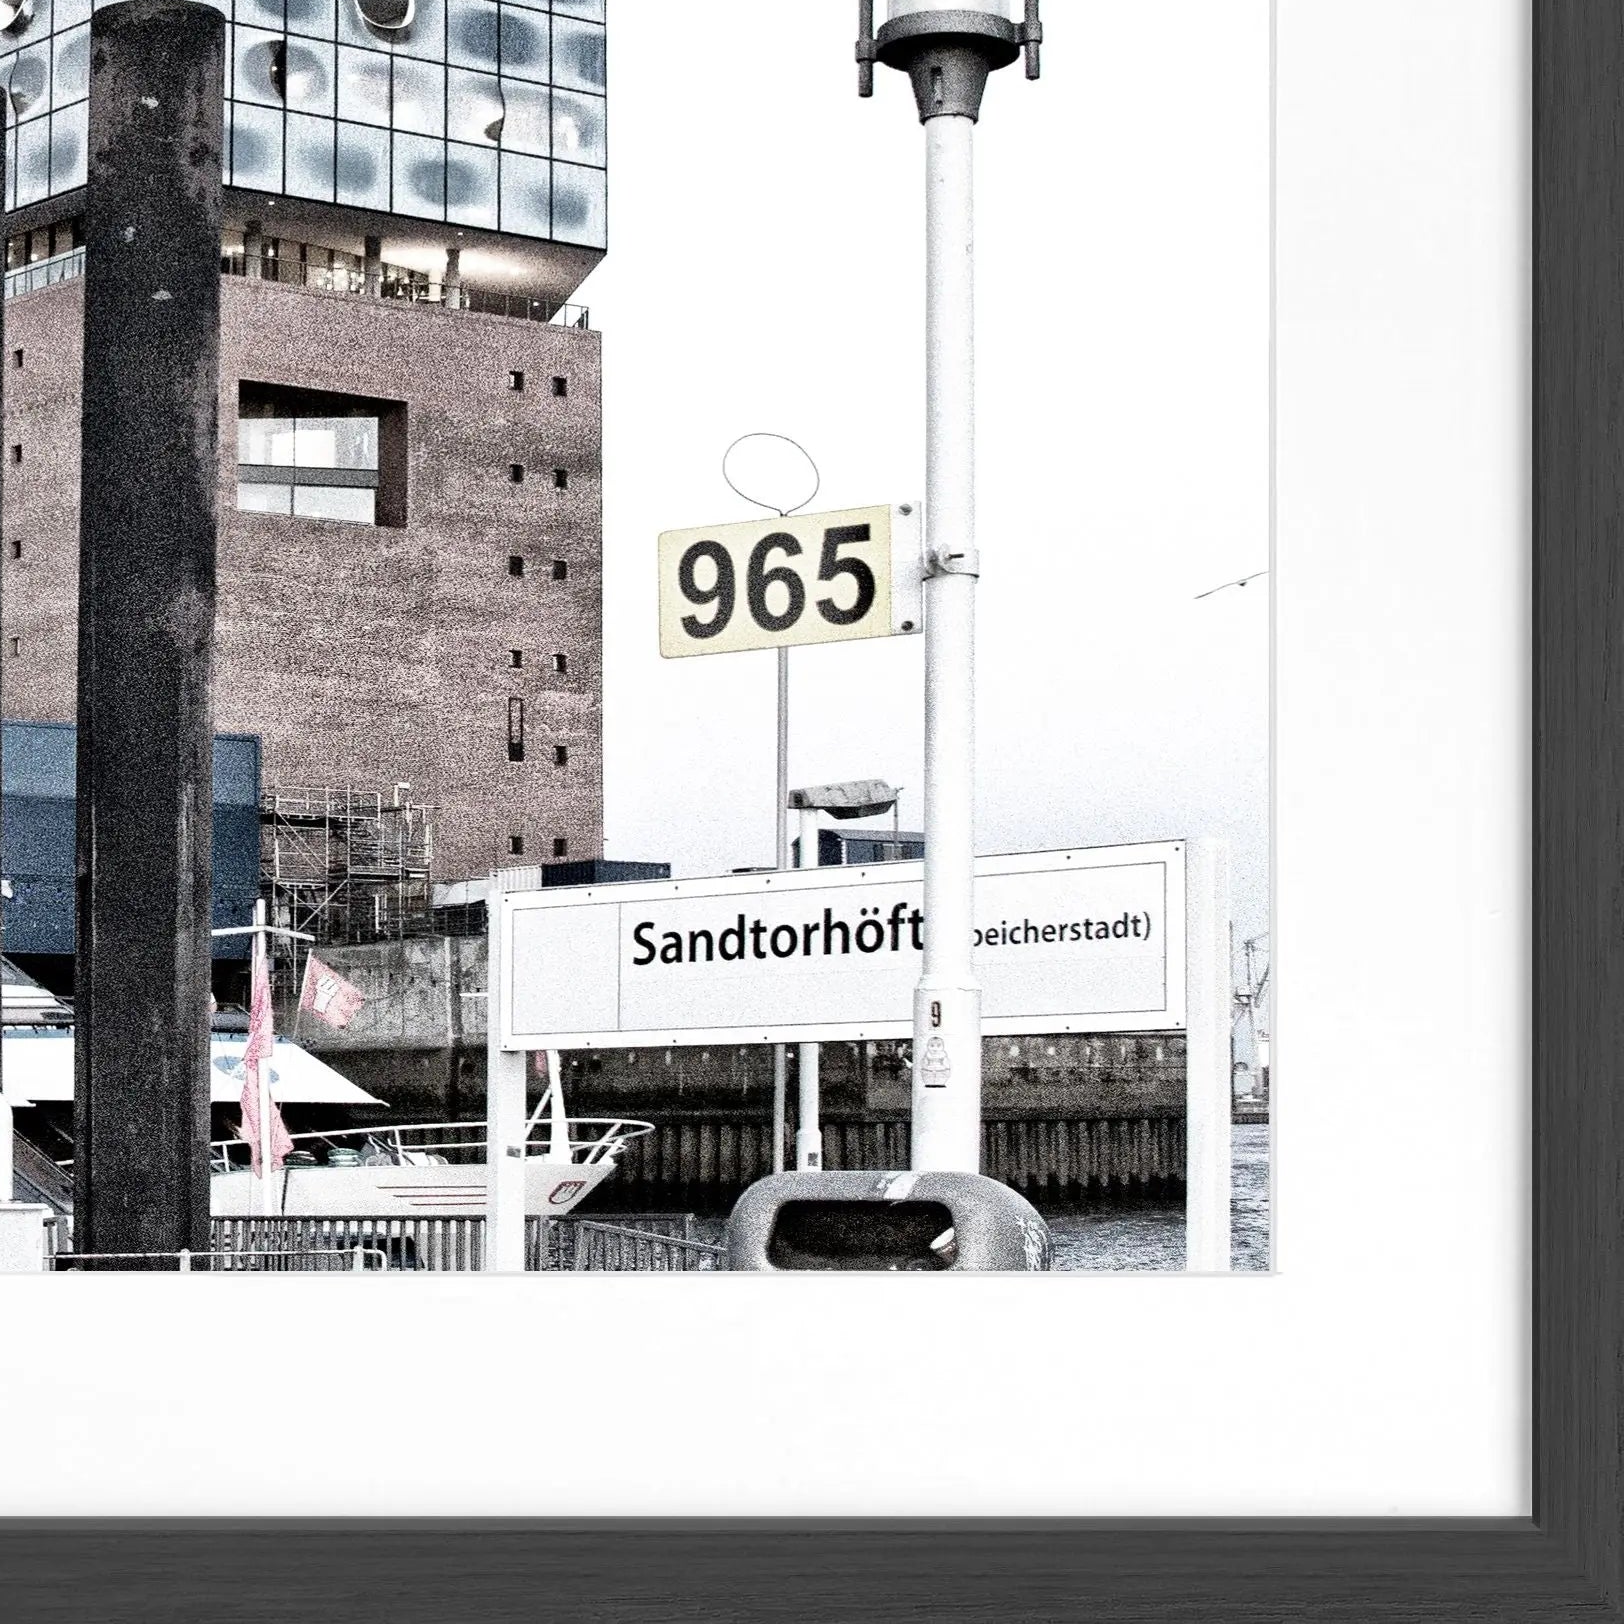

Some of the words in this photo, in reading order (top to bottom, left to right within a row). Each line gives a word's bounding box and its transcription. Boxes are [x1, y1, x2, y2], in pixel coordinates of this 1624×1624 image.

[677, 522, 876, 641] 965
[632, 901, 925, 966] Sandtorhöft
[973, 911, 1152, 947] eicherstadt)
[930, 1000, 942, 1028] 9
